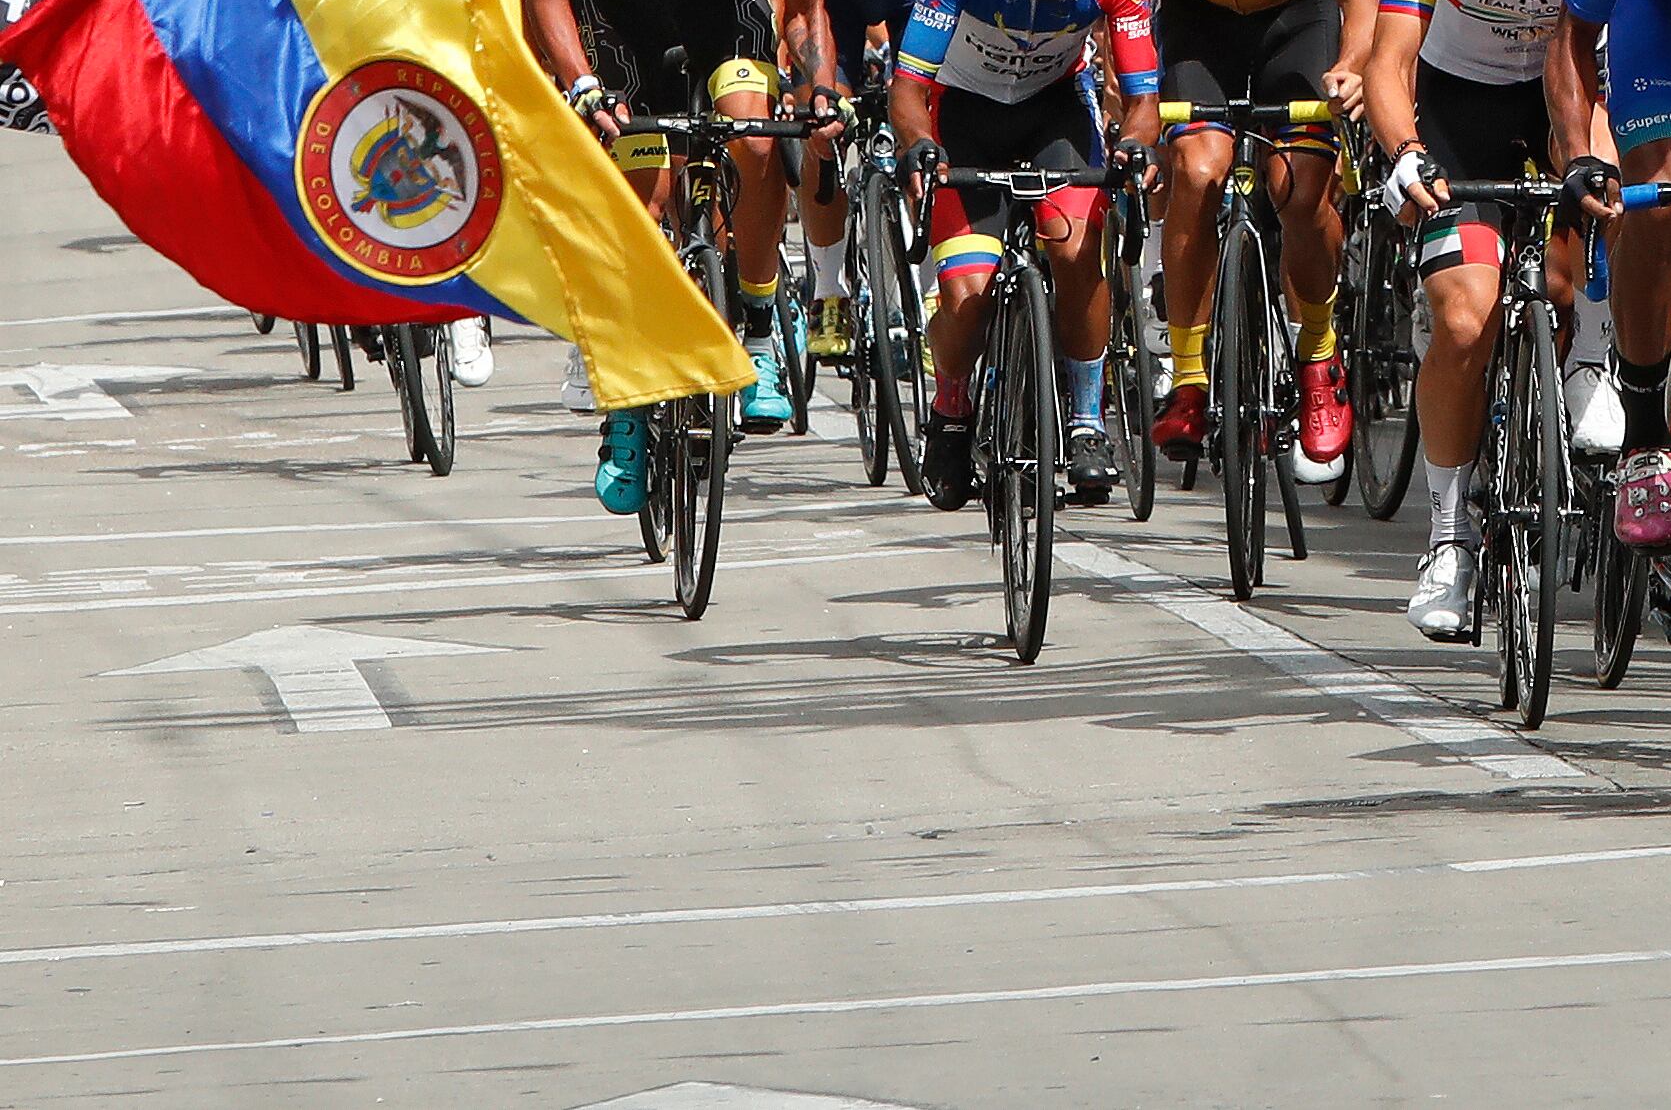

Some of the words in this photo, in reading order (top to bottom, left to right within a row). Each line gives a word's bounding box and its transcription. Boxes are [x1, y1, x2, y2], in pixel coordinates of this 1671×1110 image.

[912, 12, 952, 32] SPORT
[1127, 29, 1150, 40] SPO
[310, 121, 332, 155] DE
[397, 68, 496, 200] REPUBLICA
[311, 176, 423, 270] COLOMBIA
